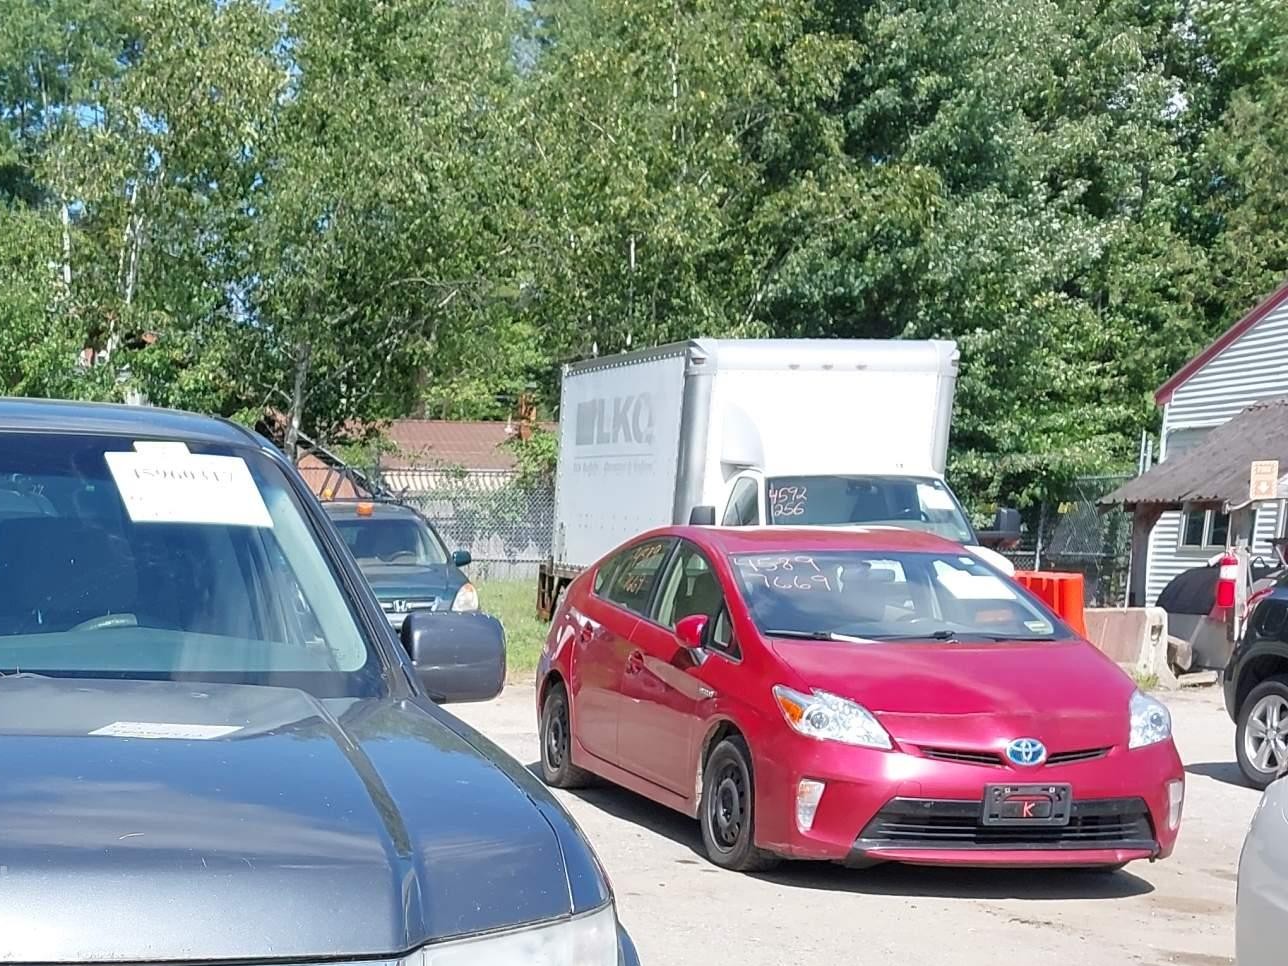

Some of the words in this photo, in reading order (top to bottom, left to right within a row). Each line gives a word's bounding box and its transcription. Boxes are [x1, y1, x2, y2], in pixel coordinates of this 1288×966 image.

[596, 392, 655, 445] LKQ
[769, 487, 807, 504] 4592
[733, 556, 821, 572] 4589
[744, 573, 831, 591] 7669
[1023, 801, 1036, 818] K
